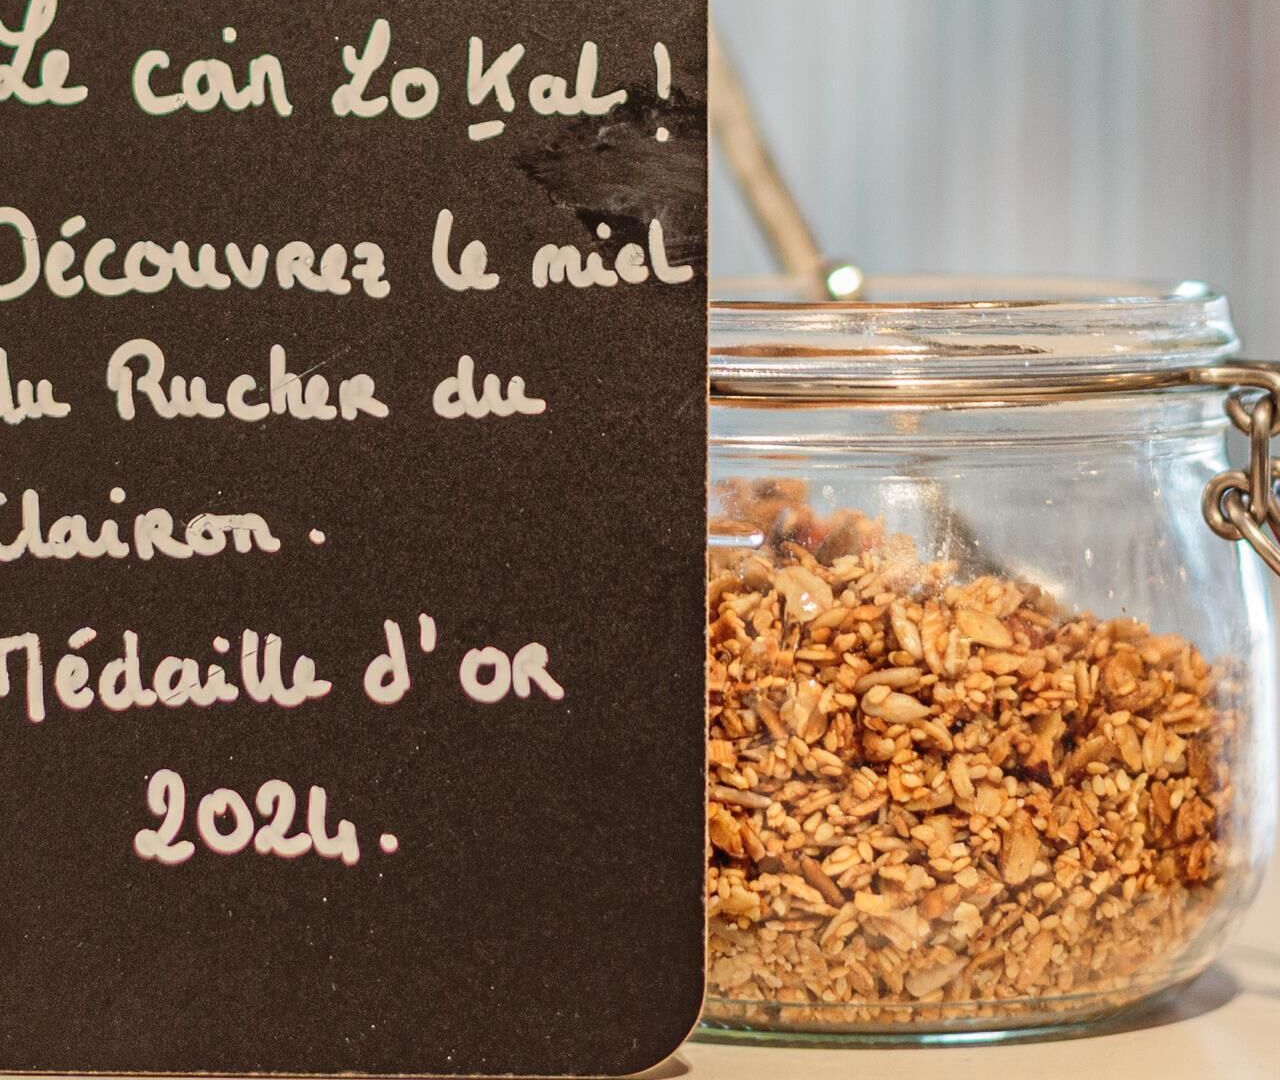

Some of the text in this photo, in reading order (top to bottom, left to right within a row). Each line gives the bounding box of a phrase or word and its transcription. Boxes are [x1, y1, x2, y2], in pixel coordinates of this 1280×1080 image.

[132, 26, 294, 117] coin
[432, 209, 500, 290] le
[532, 220, 694, 290] miel
[432, 354, 547, 420] du
